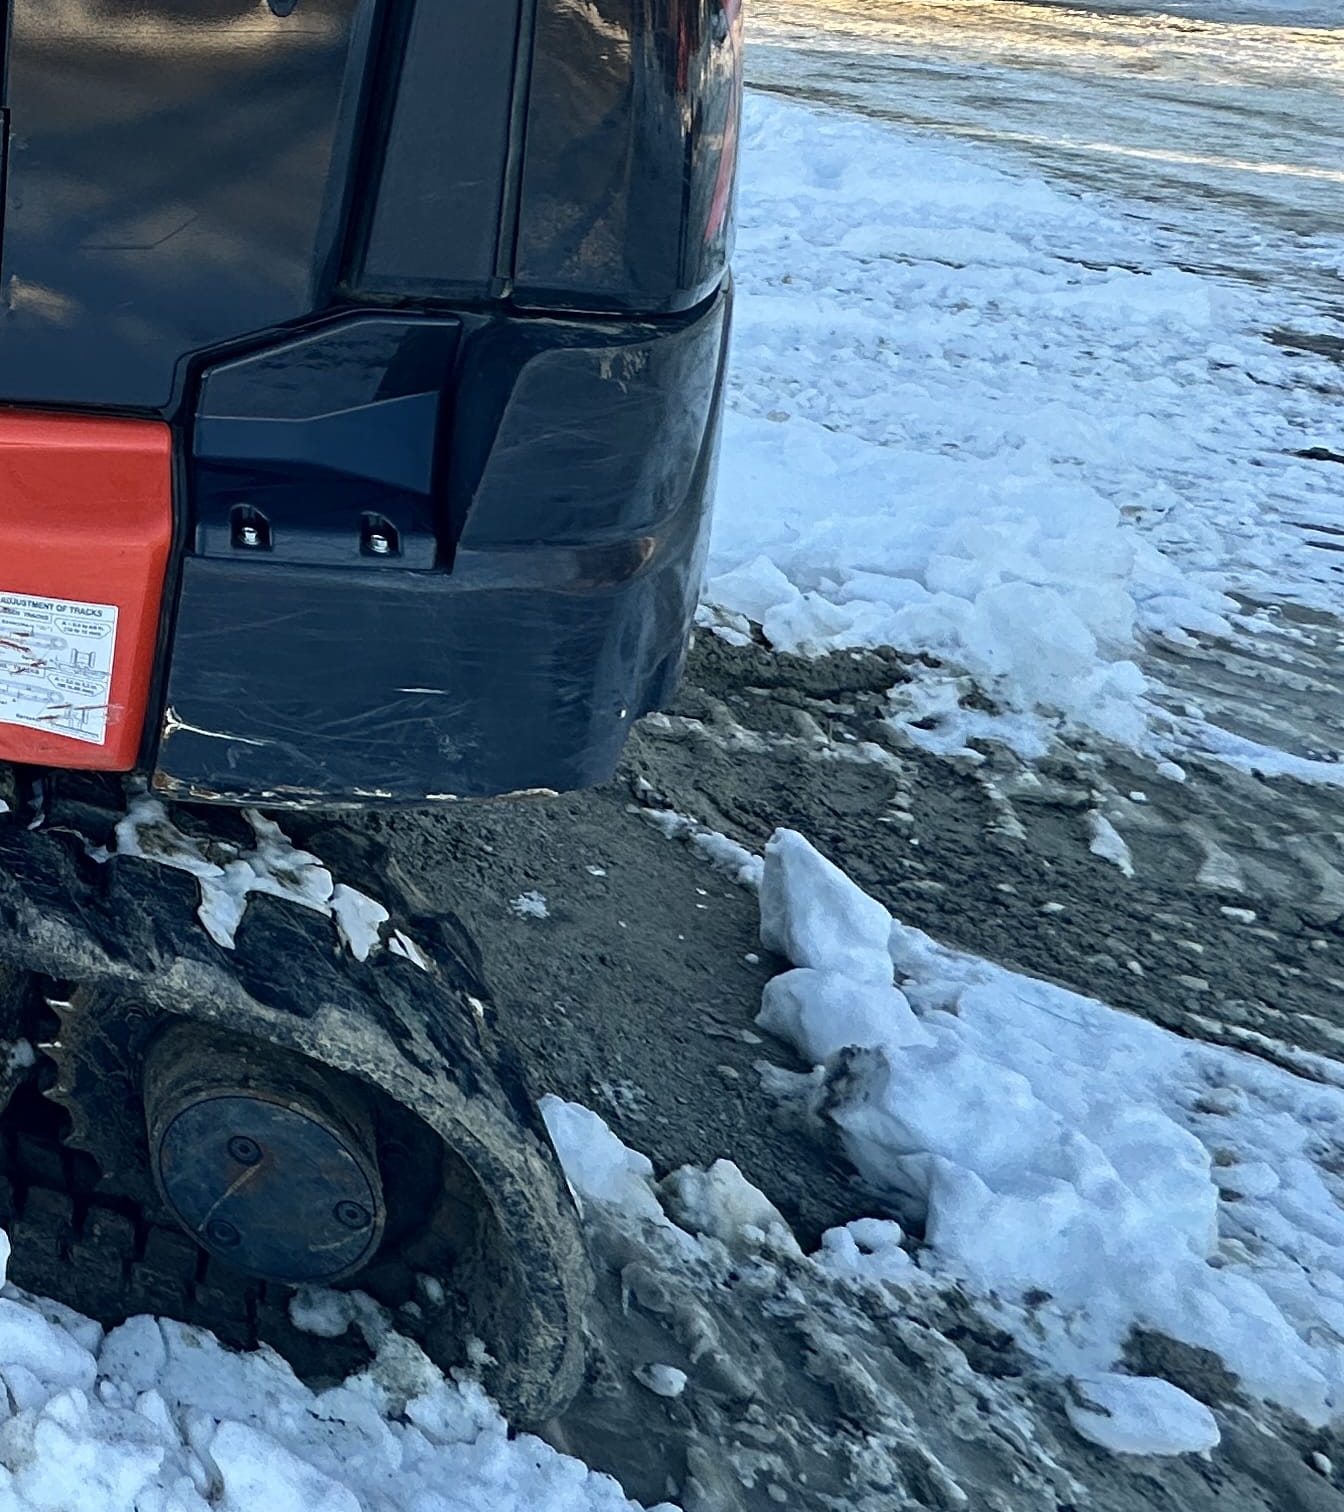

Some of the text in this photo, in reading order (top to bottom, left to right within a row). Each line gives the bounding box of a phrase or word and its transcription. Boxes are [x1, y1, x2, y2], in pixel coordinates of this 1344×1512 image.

[0, 596, 103, 618] ADJUSTMENT OF TRACKS
